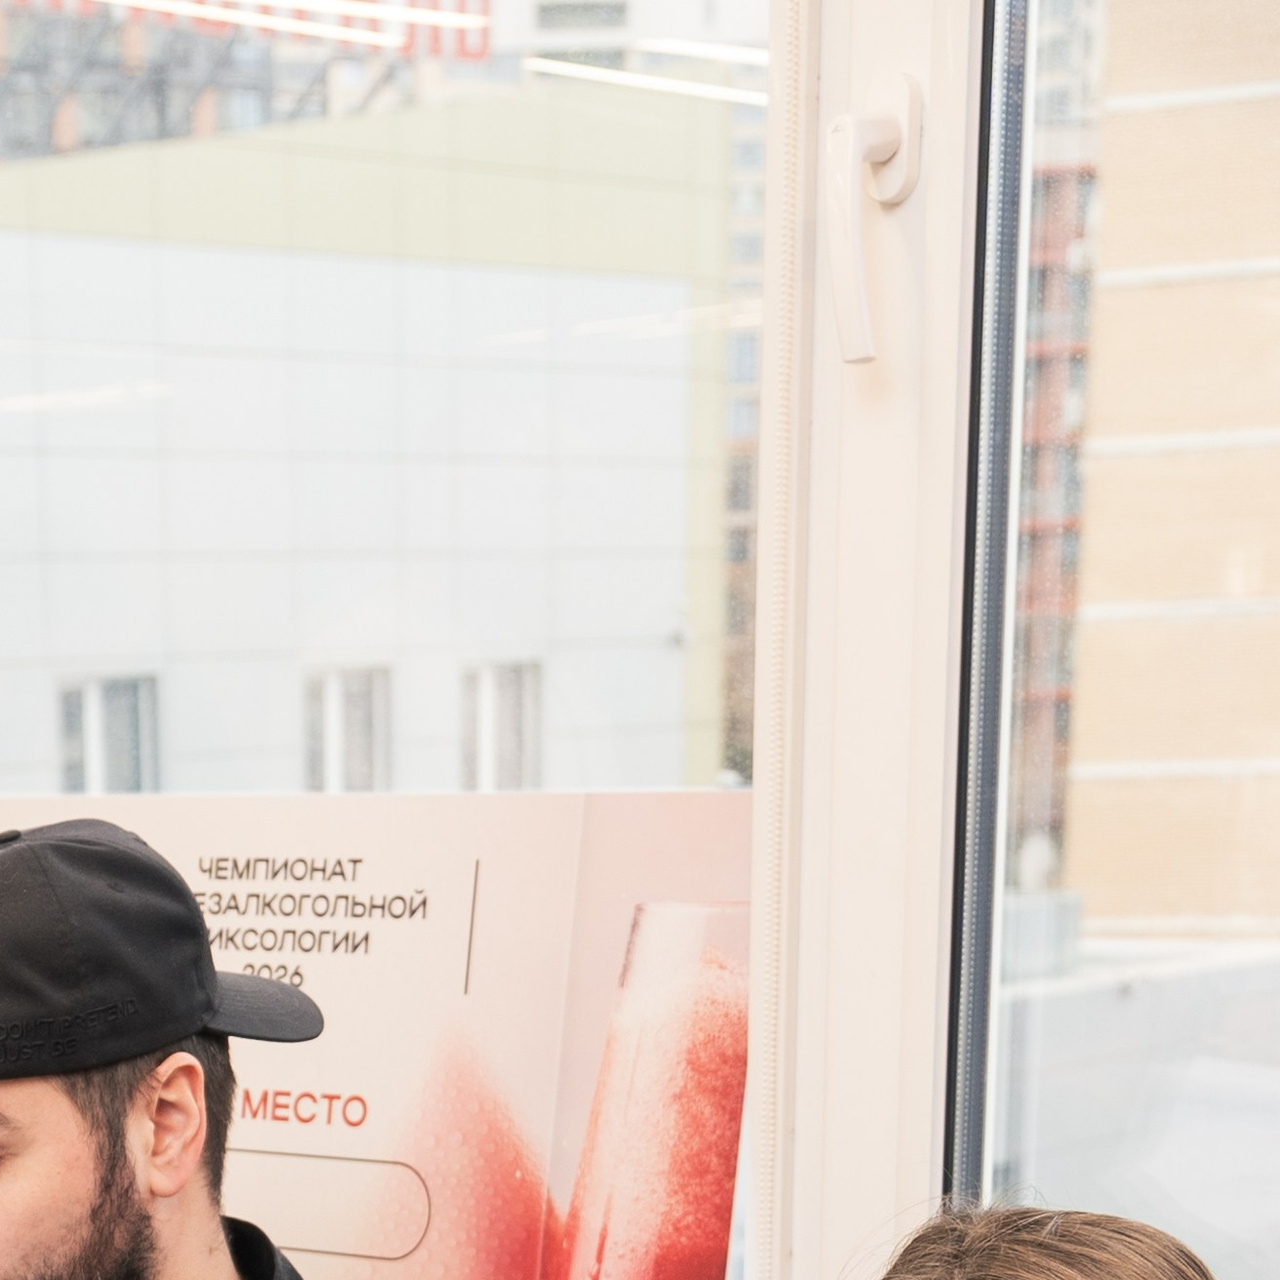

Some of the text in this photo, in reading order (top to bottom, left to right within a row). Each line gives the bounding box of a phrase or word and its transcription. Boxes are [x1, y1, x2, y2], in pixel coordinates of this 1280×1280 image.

[198, 857, 364, 882] ЧЕМПИОНАТ
[194, 888, 429, 920] ЕЗАЛКОГОЛЬНОЙ
[207, 926, 370, 955] ИКСОЛОГИИ
[240, 1089, 368, 1127] МЕСТО
